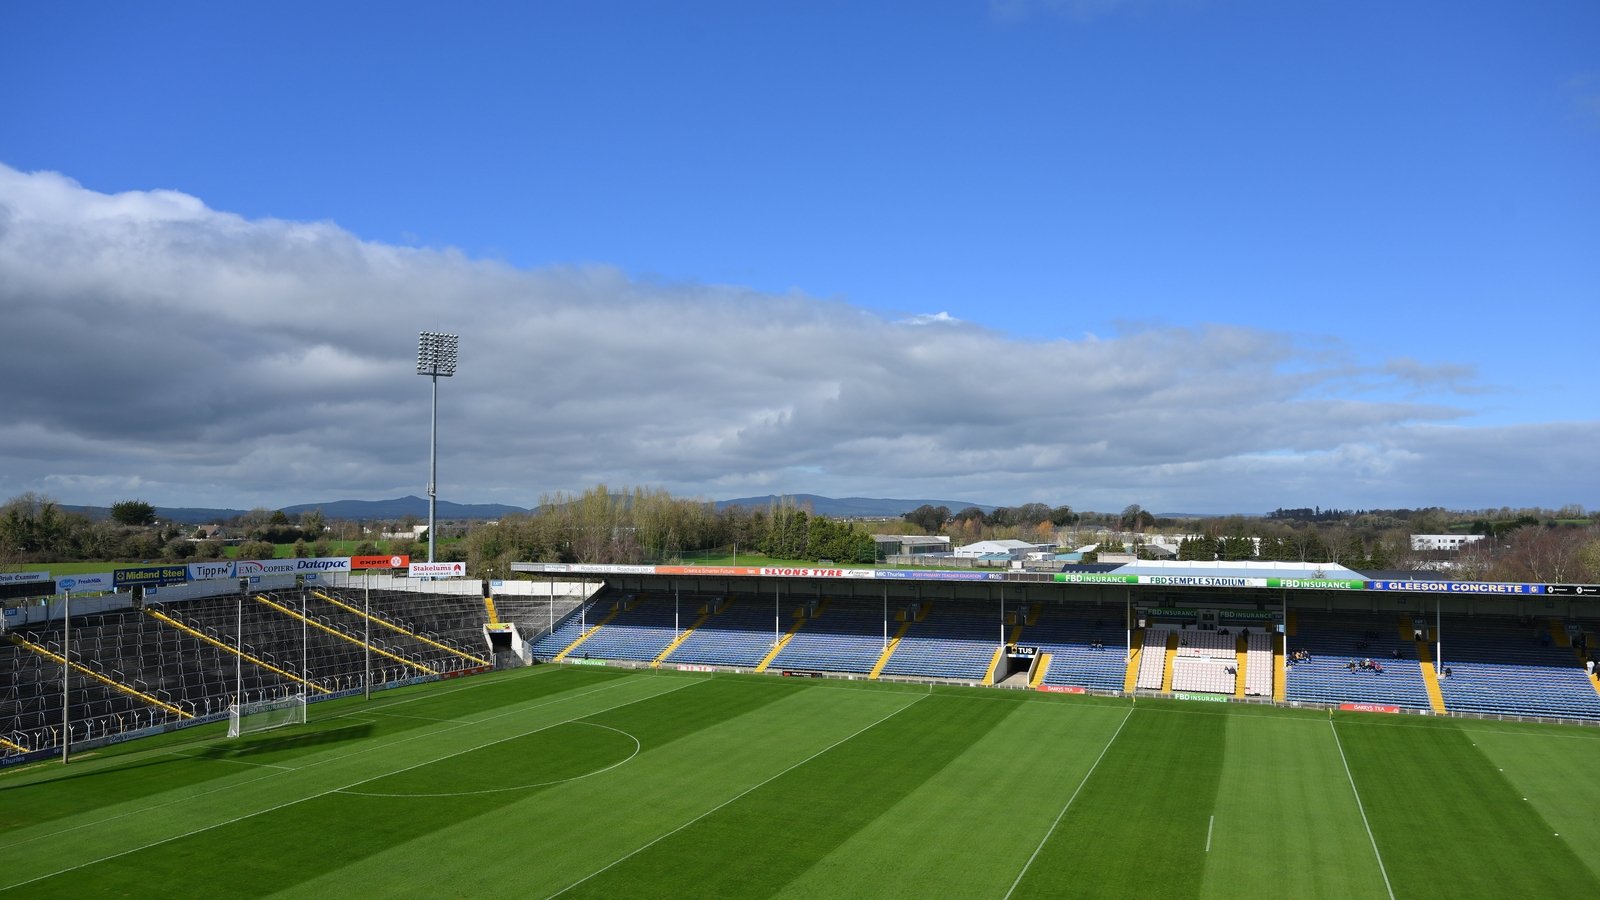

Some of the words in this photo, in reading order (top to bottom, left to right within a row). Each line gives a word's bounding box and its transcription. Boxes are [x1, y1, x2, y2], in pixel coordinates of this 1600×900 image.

[238, 566, 258, 574] EMS
[263, 565, 294, 573] COPIERS
[297, 560, 348, 570] Datapac
[413, 564, 452, 572] Stakelums
[125, 570, 160, 580] Midland
[162, 568, 185, 578] Steel
[771, 568, 809, 576] LYONS
[812, 569, 843, 577] TYRE
[1065, 574, 1082, 583] FBD
[1083, 575, 1127, 583] INSURANCE
[1150, 576, 1167, 584] FBD
[1168, 577, 1203, 585] SEMPLE
[1203, 577, 1246, 586] STADIUM
[1280, 579, 1300, 588] FBD
[1300, 580, 1351, 589] INSURANCE
[1388, 582, 1448, 591] GLEESON
[1451, 583, 1523, 593] CONCRETE
[1147, 608, 1162, 616] FBD
[1175, 693, 1190, 701] FBD
[1190, 695, 1228, 703] INSURANCE
[183, 717, 207, 727] CAMPION
[2, 756, 26, 765] Thurles
